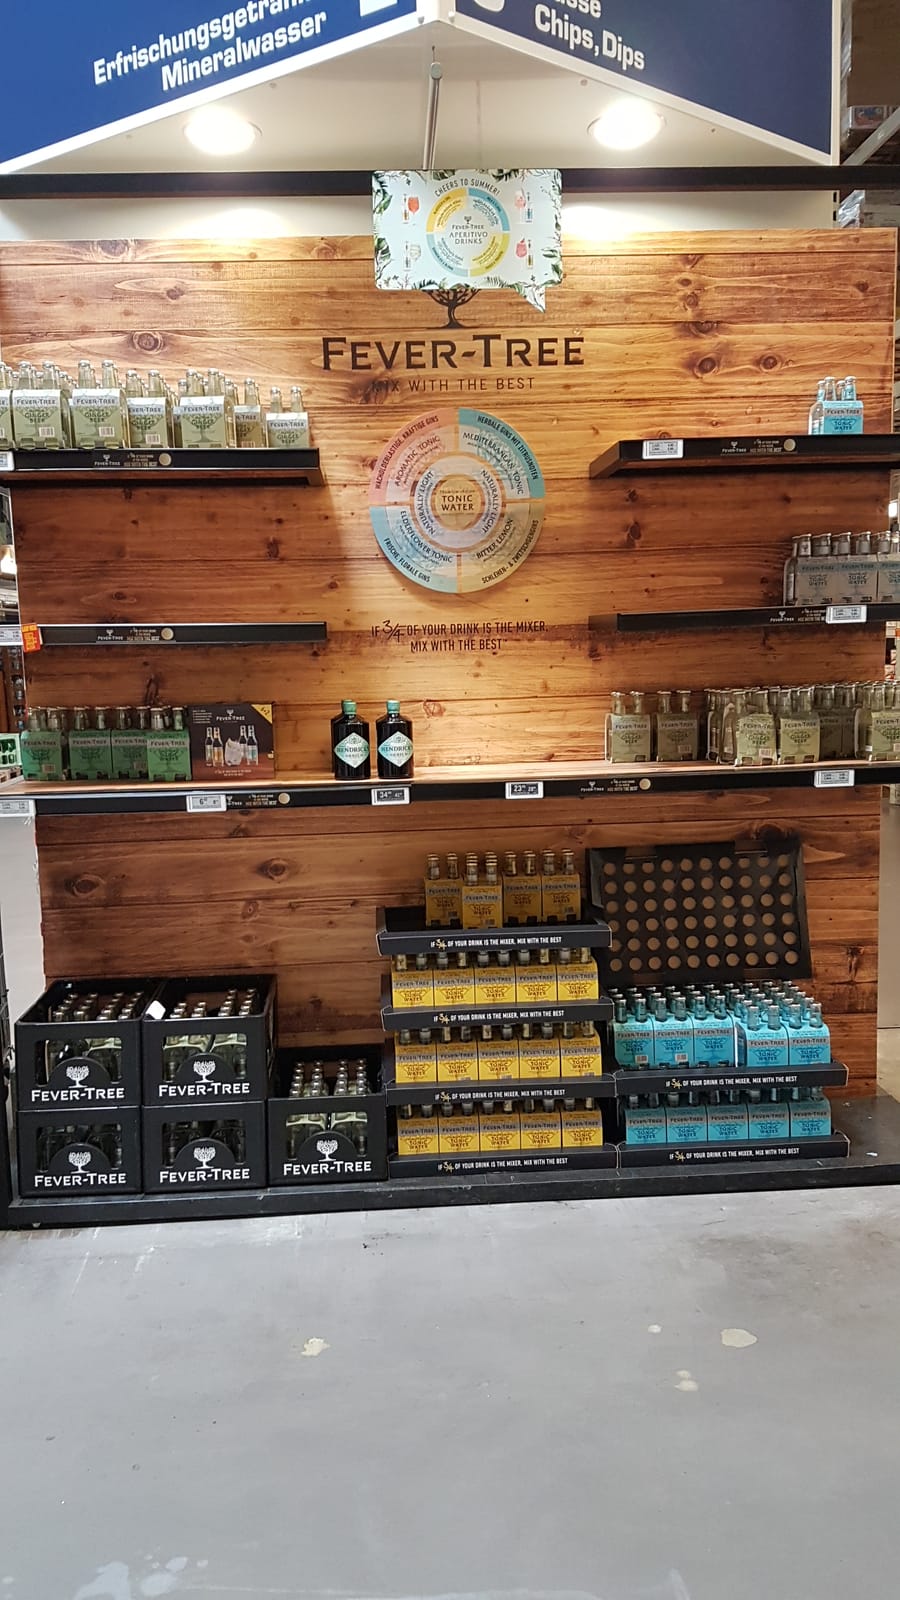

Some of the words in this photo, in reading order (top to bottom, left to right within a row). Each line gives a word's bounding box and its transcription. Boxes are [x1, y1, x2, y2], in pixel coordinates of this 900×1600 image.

[162, 11, 327, 91] Mineralwasser
[434, 180, 458, 197] CHEERS
[461, 178, 468, 186] TO
[470, 178, 500, 196] SUMMER!
[322, 334, 585, 371] FEVER-TREE
[372, 379, 400, 393] MIX
[409, 378, 448, 392] WITH
[458, 378, 487, 390] THE
[496, 377, 535, 390] BEST
[402, 421, 426, 439] KRAFTIGE
[426, 416, 438, 425] GINS
[478, 416, 500, 430] HERBALE
[500, 426, 512, 438] GINS
[511, 436, 520, 447] MIT
[518, 445, 539, 480] ZITRUSNOTEN
[395, 450, 418, 486] AROMATIC
[418, 436, 440, 450] TONIC
[463, 432, 516, 469] MEDITERRANEAN
[513, 471, 524, 495] TONIC
[420, 471, 434, 492] LIGHT
[481, 470, 499, 511] NATURALLY
[417, 496, 435, 534] NATURALLY
[482, 511, 497, 533] LIGHT
[401, 511, 431, 553] ELDERFLOWER
[432, 550, 453, 563] TONIC
[476, 542, 498, 559] BITTER
[496, 518, 513, 544] LEMON
[399, 557, 418, 576] FLORALE
[418, 572, 431, 582] GINS
[372, 626, 380, 638] IF
[407, 625, 419, 636] OF
[421, 624, 446, 635] YOUR
[450, 623, 479, 635] DRINK
[483, 623, 492, 634] IS
[495, 622, 512, 633] THE
[411, 640, 428, 653] MIX
[431, 640, 454, 652] WITH
[458, 639, 476, 650] THE
[32, 1087, 124, 1102] FEVER-TREE
[158, 1082, 250, 1097] FEVER-TREE
[160, 1168, 250, 1184] FEVER-TREE
[283, 1161, 372, 1176] FEVER-TREE
[34, 1172, 126, 1188] FEVER-TREE
